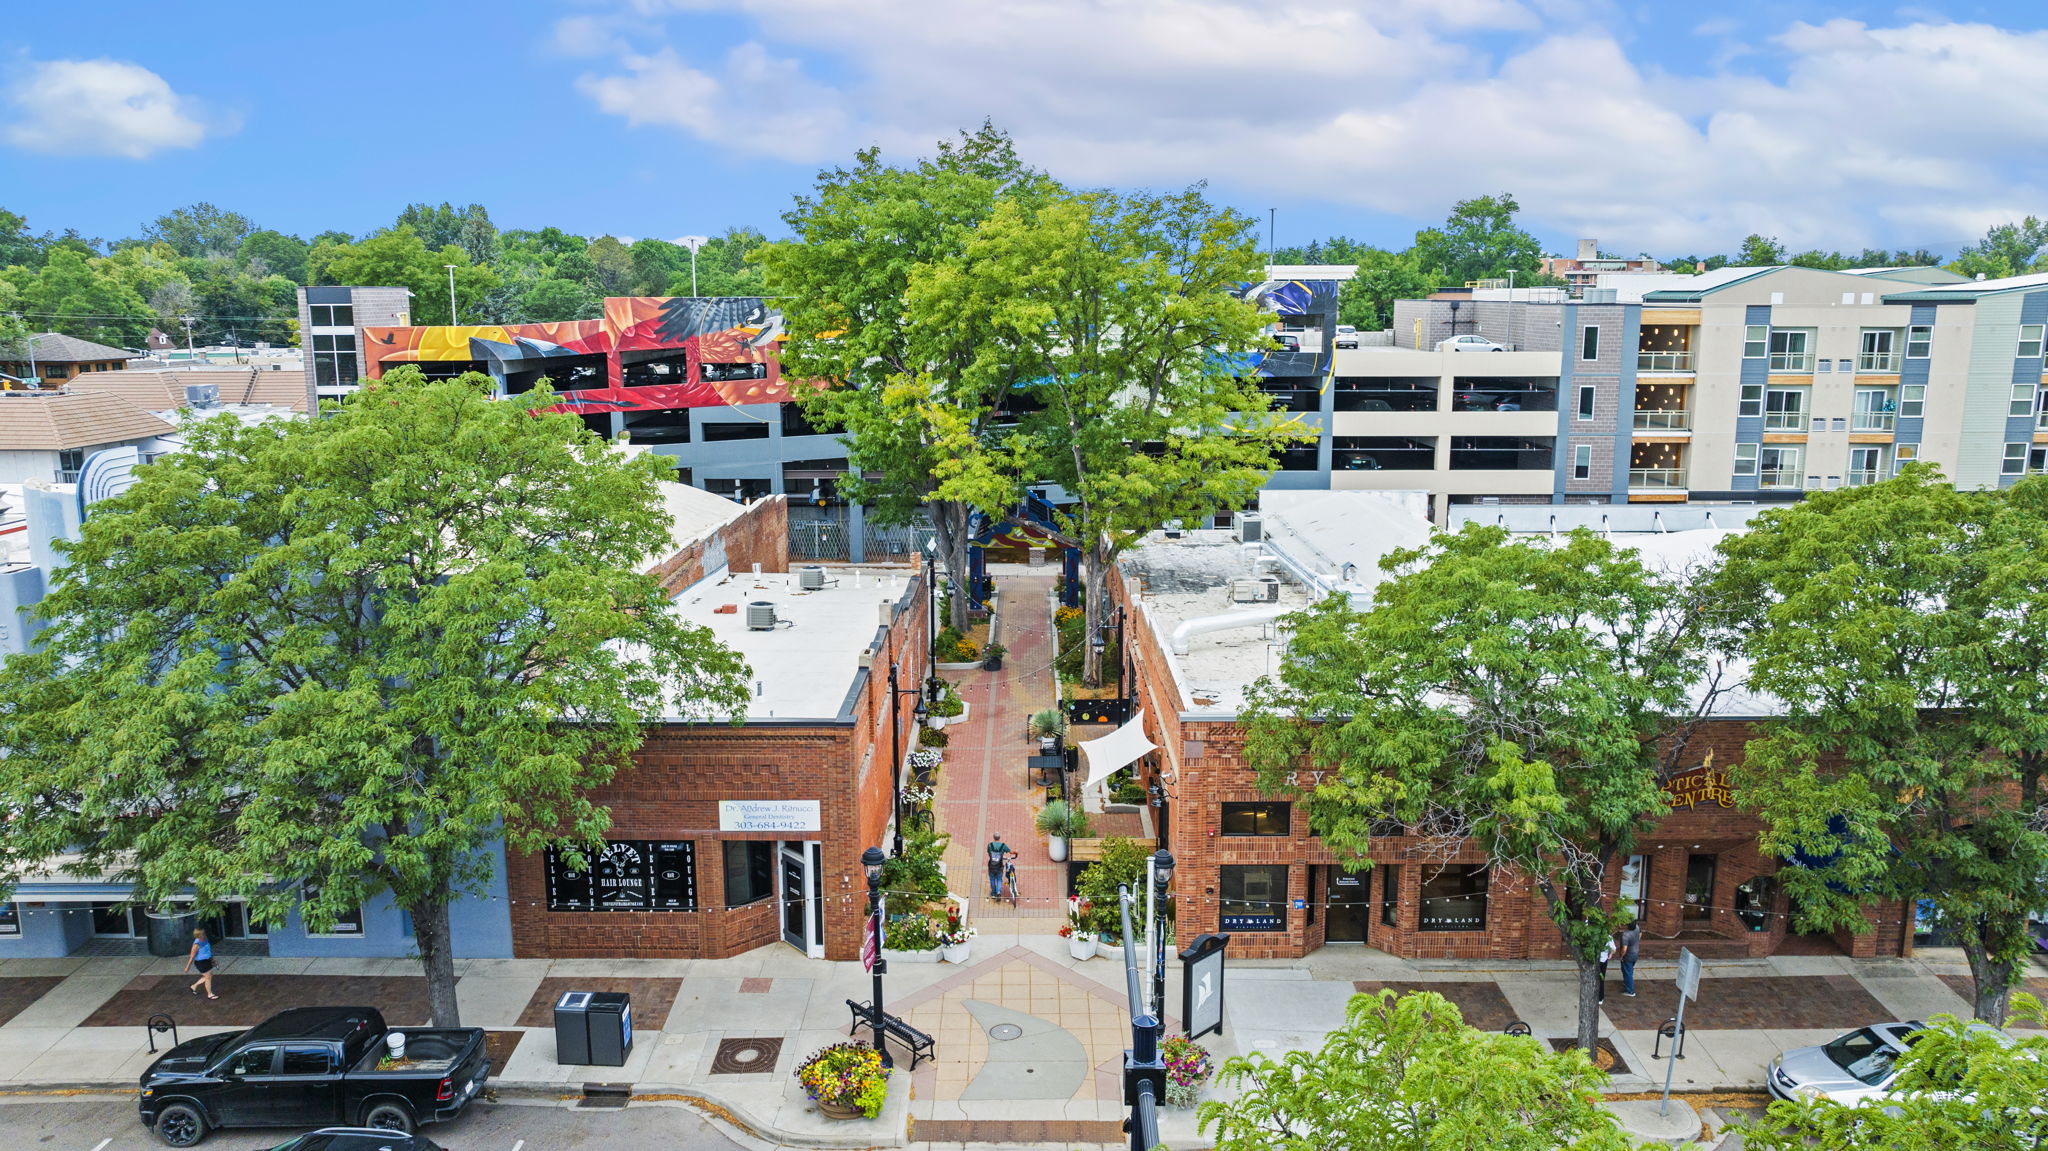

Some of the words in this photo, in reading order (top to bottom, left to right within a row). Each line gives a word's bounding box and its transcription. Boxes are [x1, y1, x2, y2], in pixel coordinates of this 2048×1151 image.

[1660, 769, 1731, 793] PTICAL
[1667, 787, 1736, 811] ENTRE
[734, 821, 806, 829] 303-684-9422
[600, 843, 641, 864] VELVET
[600, 878, 617, 887] HAIR
[618, 878, 643, 887] LOUNGE
[648, 843, 656, 907] VELVET
